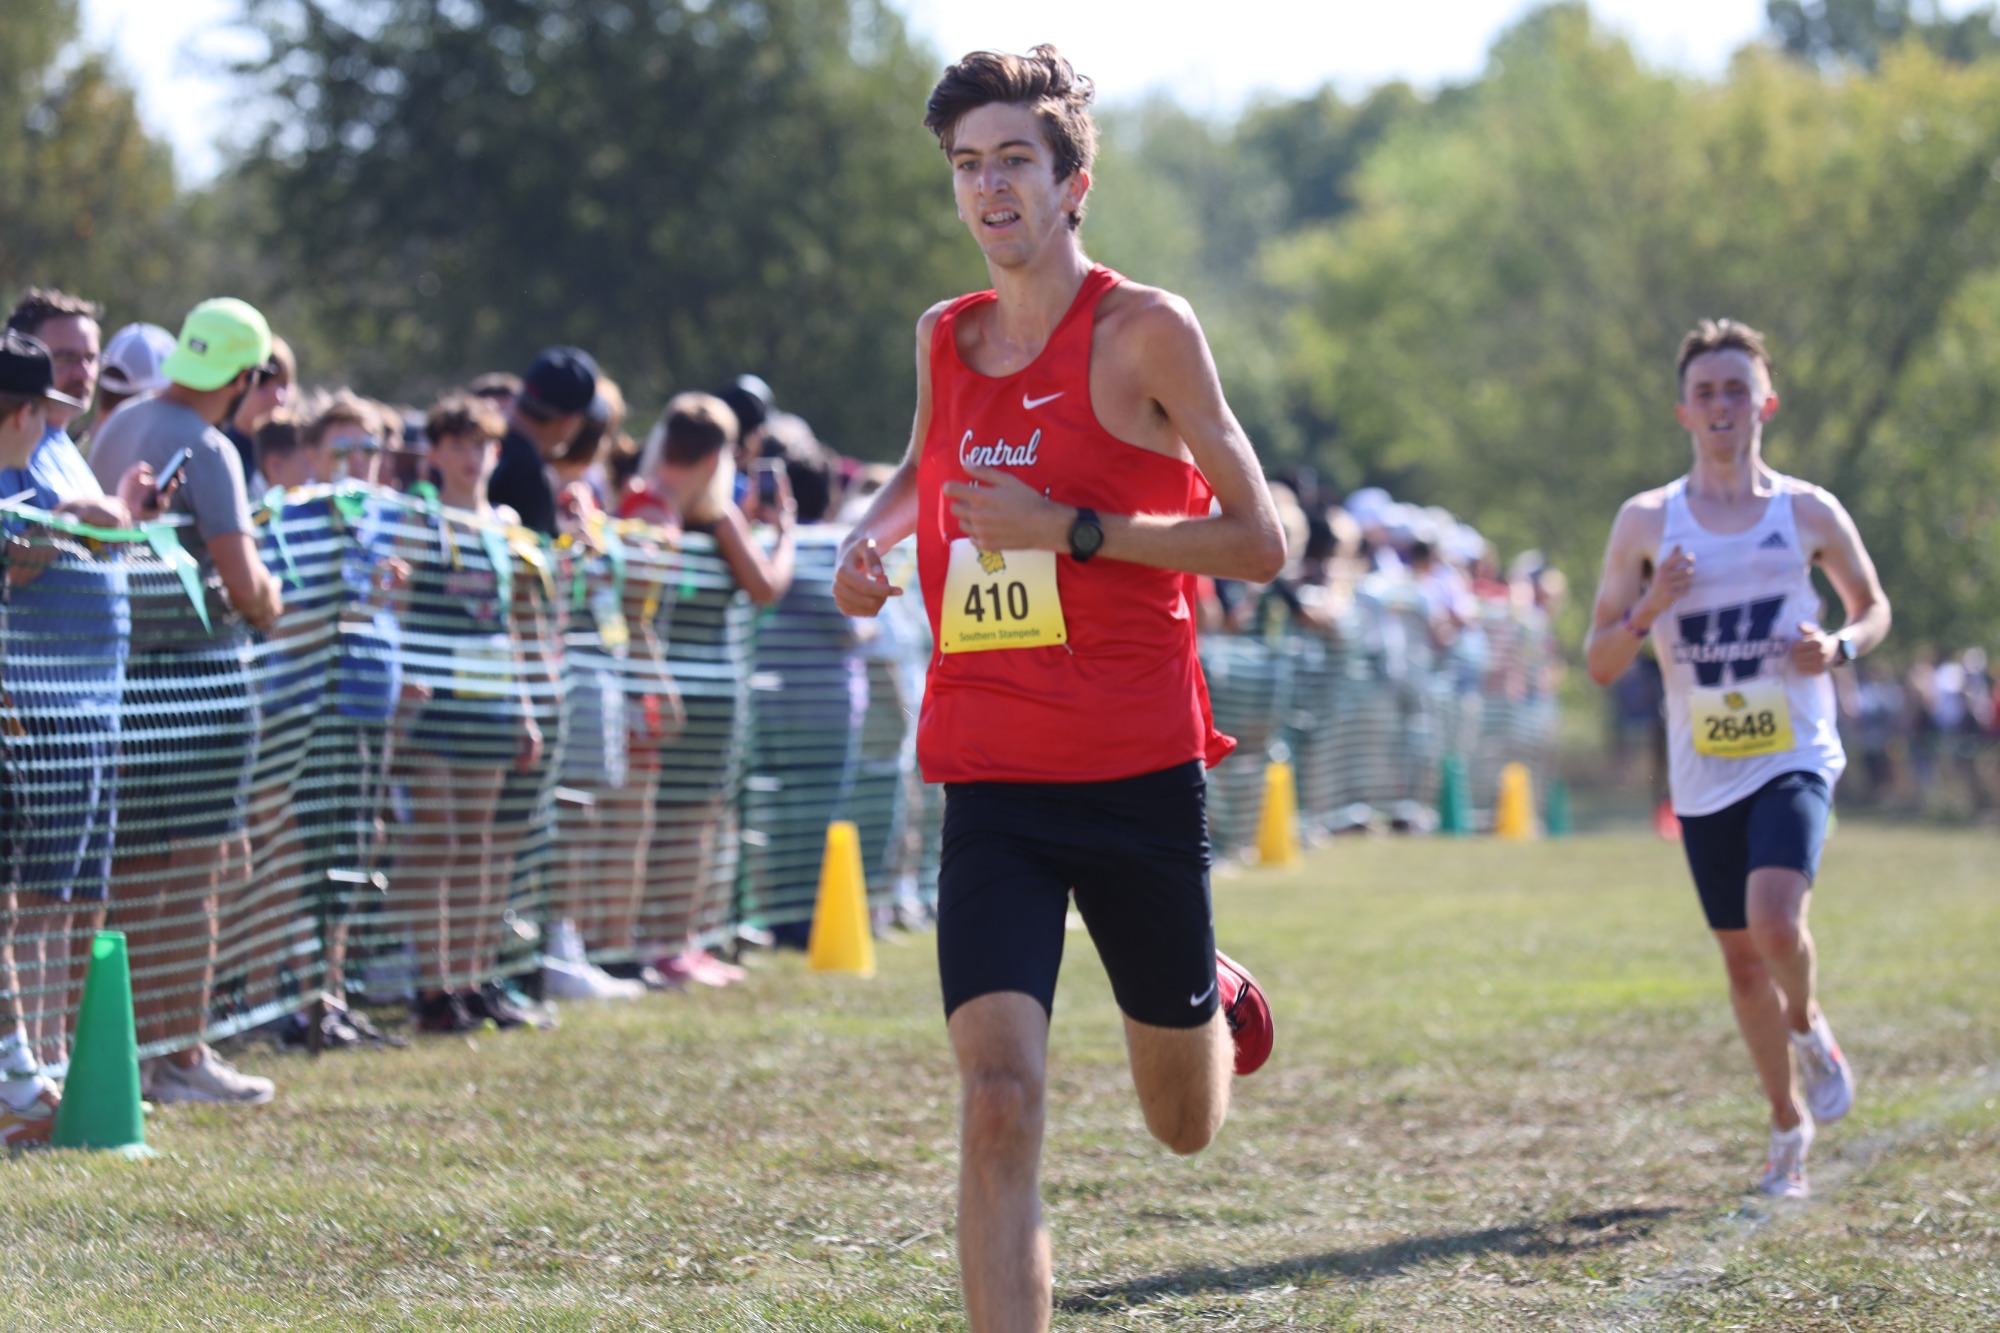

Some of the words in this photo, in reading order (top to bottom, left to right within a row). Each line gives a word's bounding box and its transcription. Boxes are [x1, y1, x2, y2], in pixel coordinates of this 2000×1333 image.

[959, 428, 1041, 466] Central
[964, 581, 1029, 623] 410
[959, 630, 996, 642] Southern
[998, 627, 1040, 640] Stampede
[1678, 594, 1787, 687] W
[1705, 711, 1776, 742] 2648
